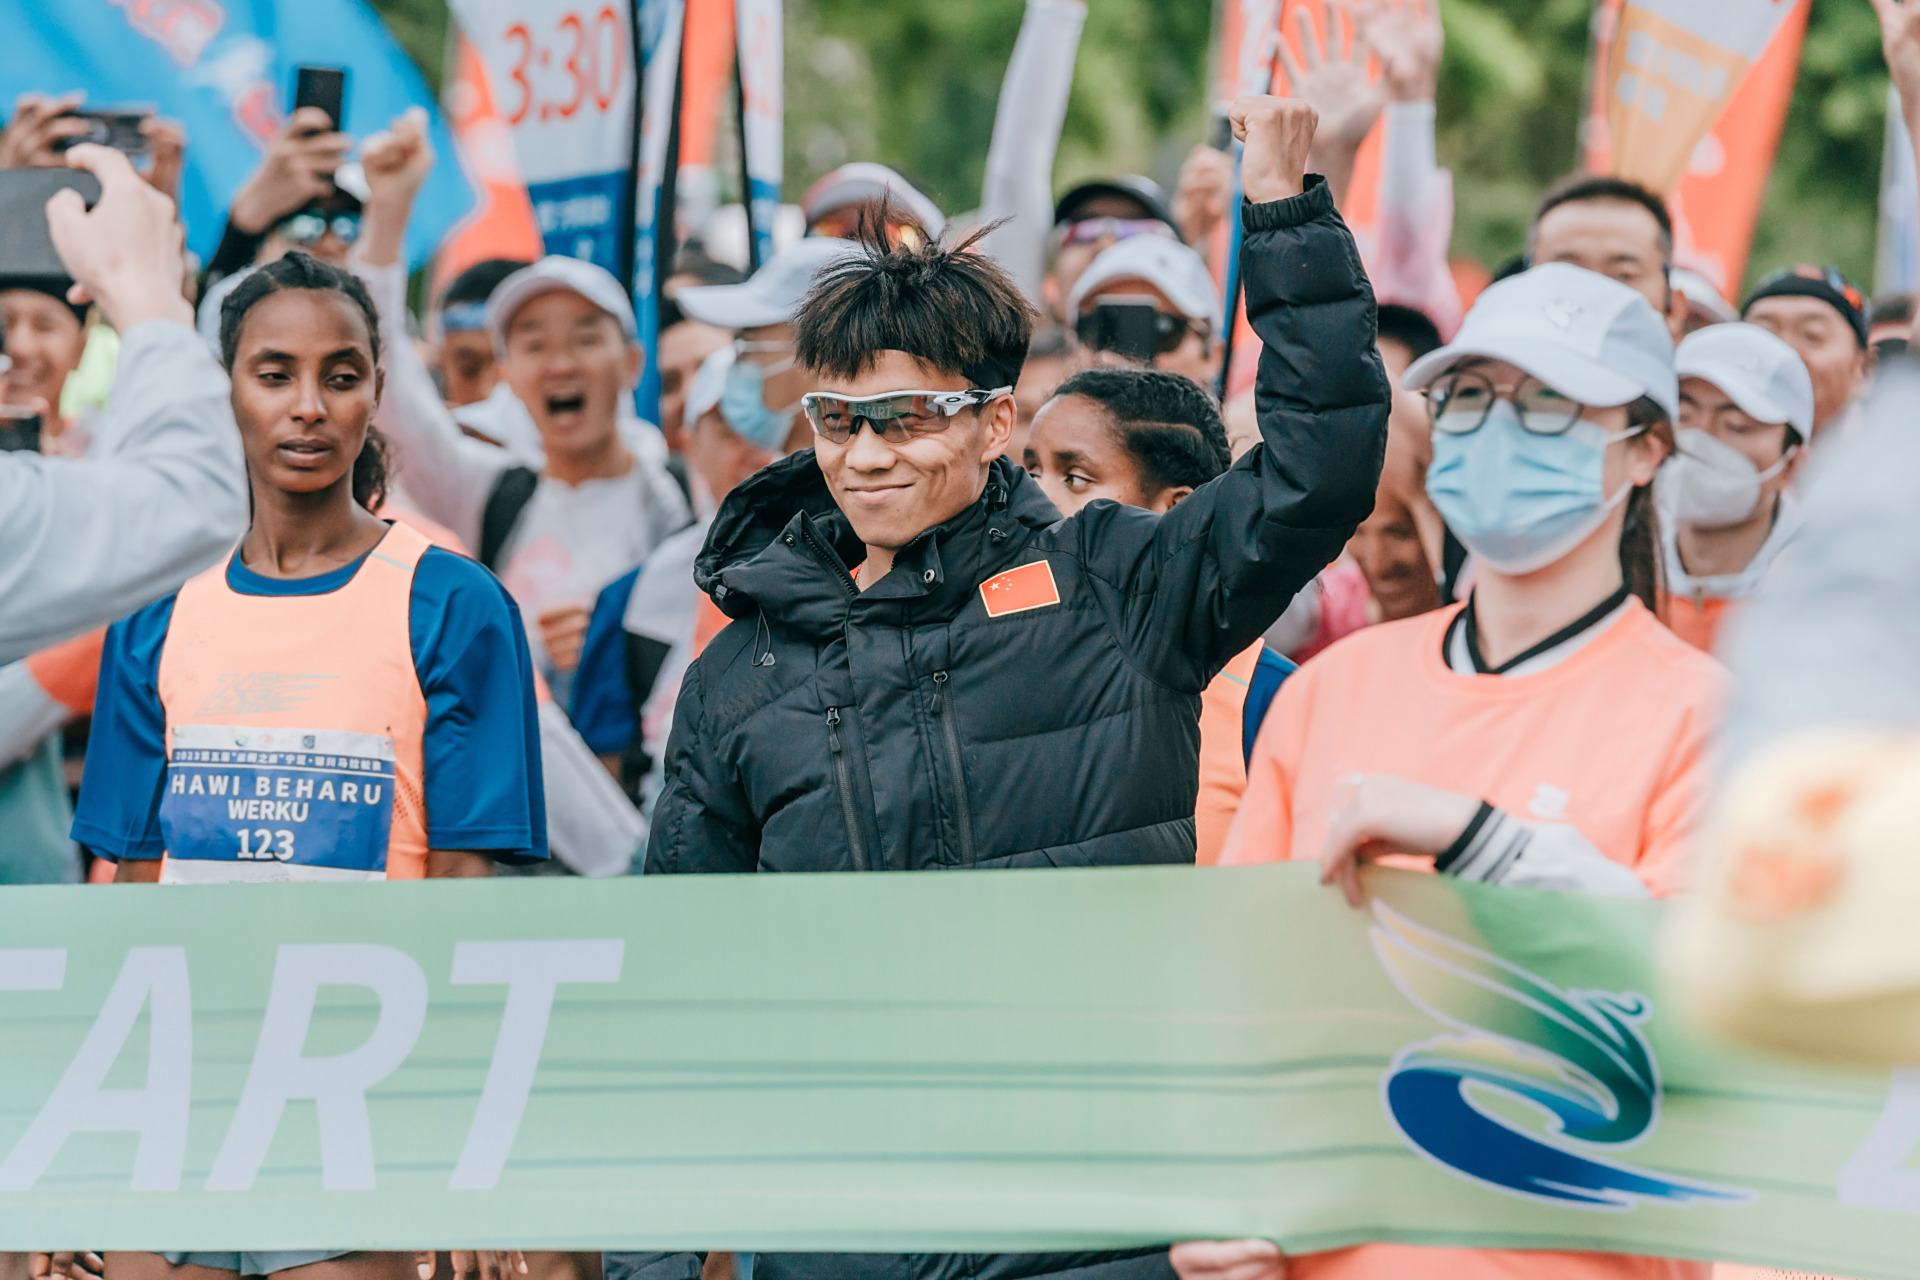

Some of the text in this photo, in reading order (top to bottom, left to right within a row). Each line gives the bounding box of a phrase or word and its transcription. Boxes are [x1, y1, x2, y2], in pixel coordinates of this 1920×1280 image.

[504, 8, 626, 126] 3:30
[856, 404, 893, 419] START
[171, 773, 382, 806] HAWI BEHARU
[227, 799, 309, 823] WERKU
[236, 828, 295, 862] 123
[0, 938, 626, 1192] ART
